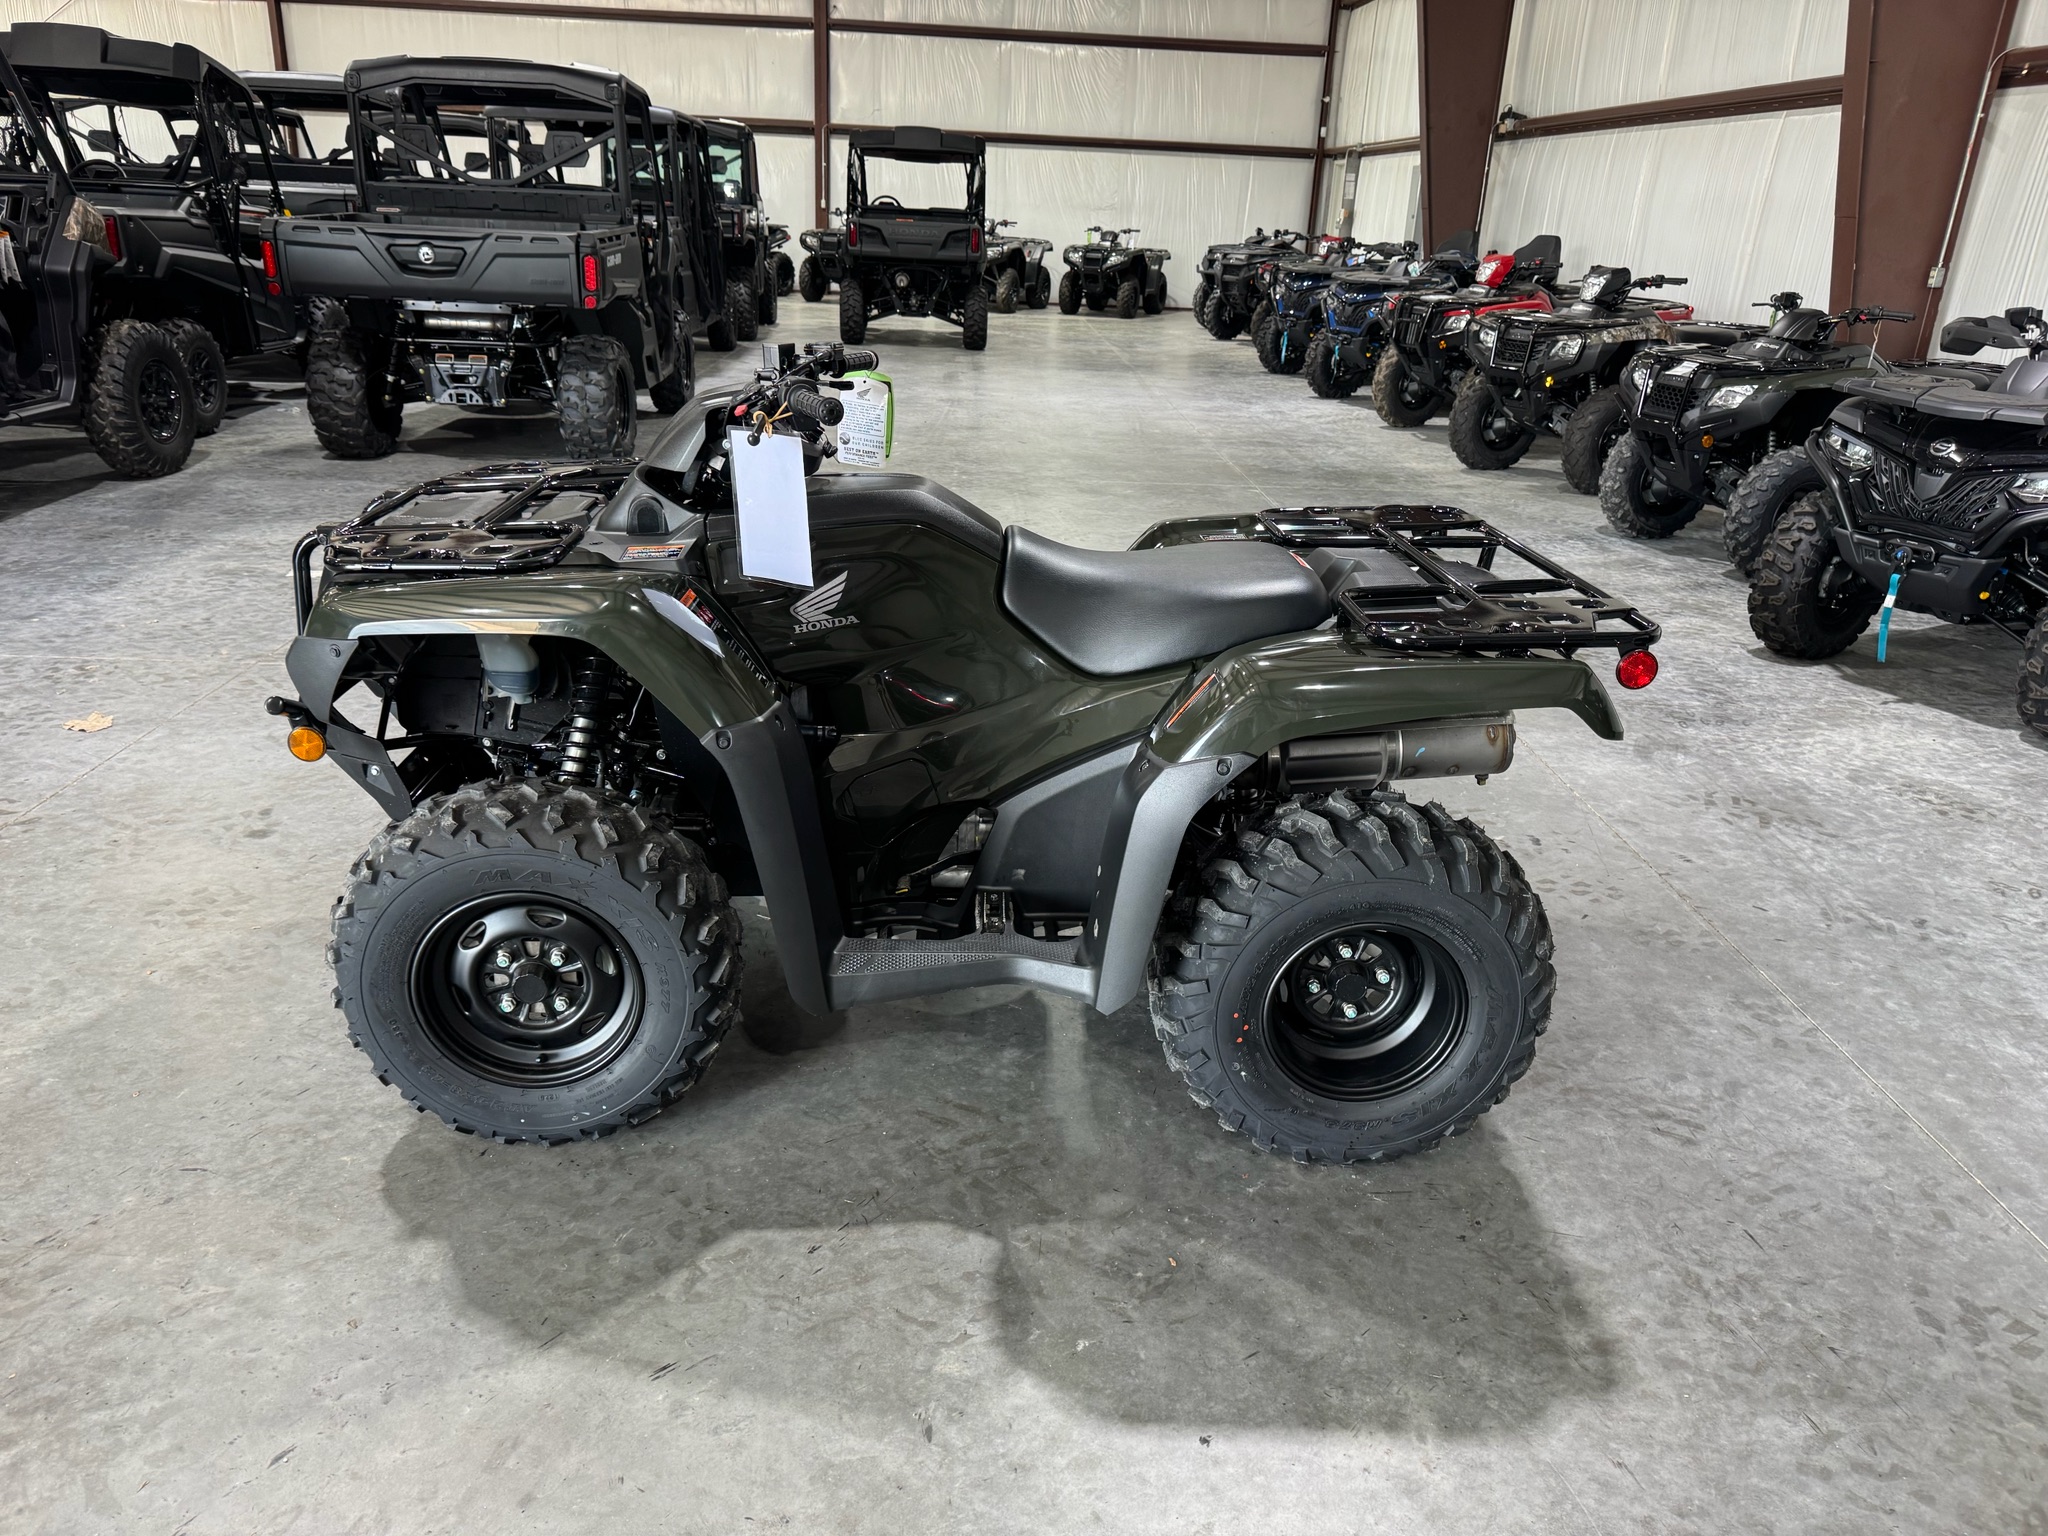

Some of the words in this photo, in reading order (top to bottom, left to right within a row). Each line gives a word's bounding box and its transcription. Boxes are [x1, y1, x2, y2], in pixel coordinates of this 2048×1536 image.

[888, 227, 939, 236] HONDA
[793, 615, 860, 634] HONDA
[473, 867, 660, 953] MAXXIS
[1390, 985, 1504, 1125] MAXXIS
